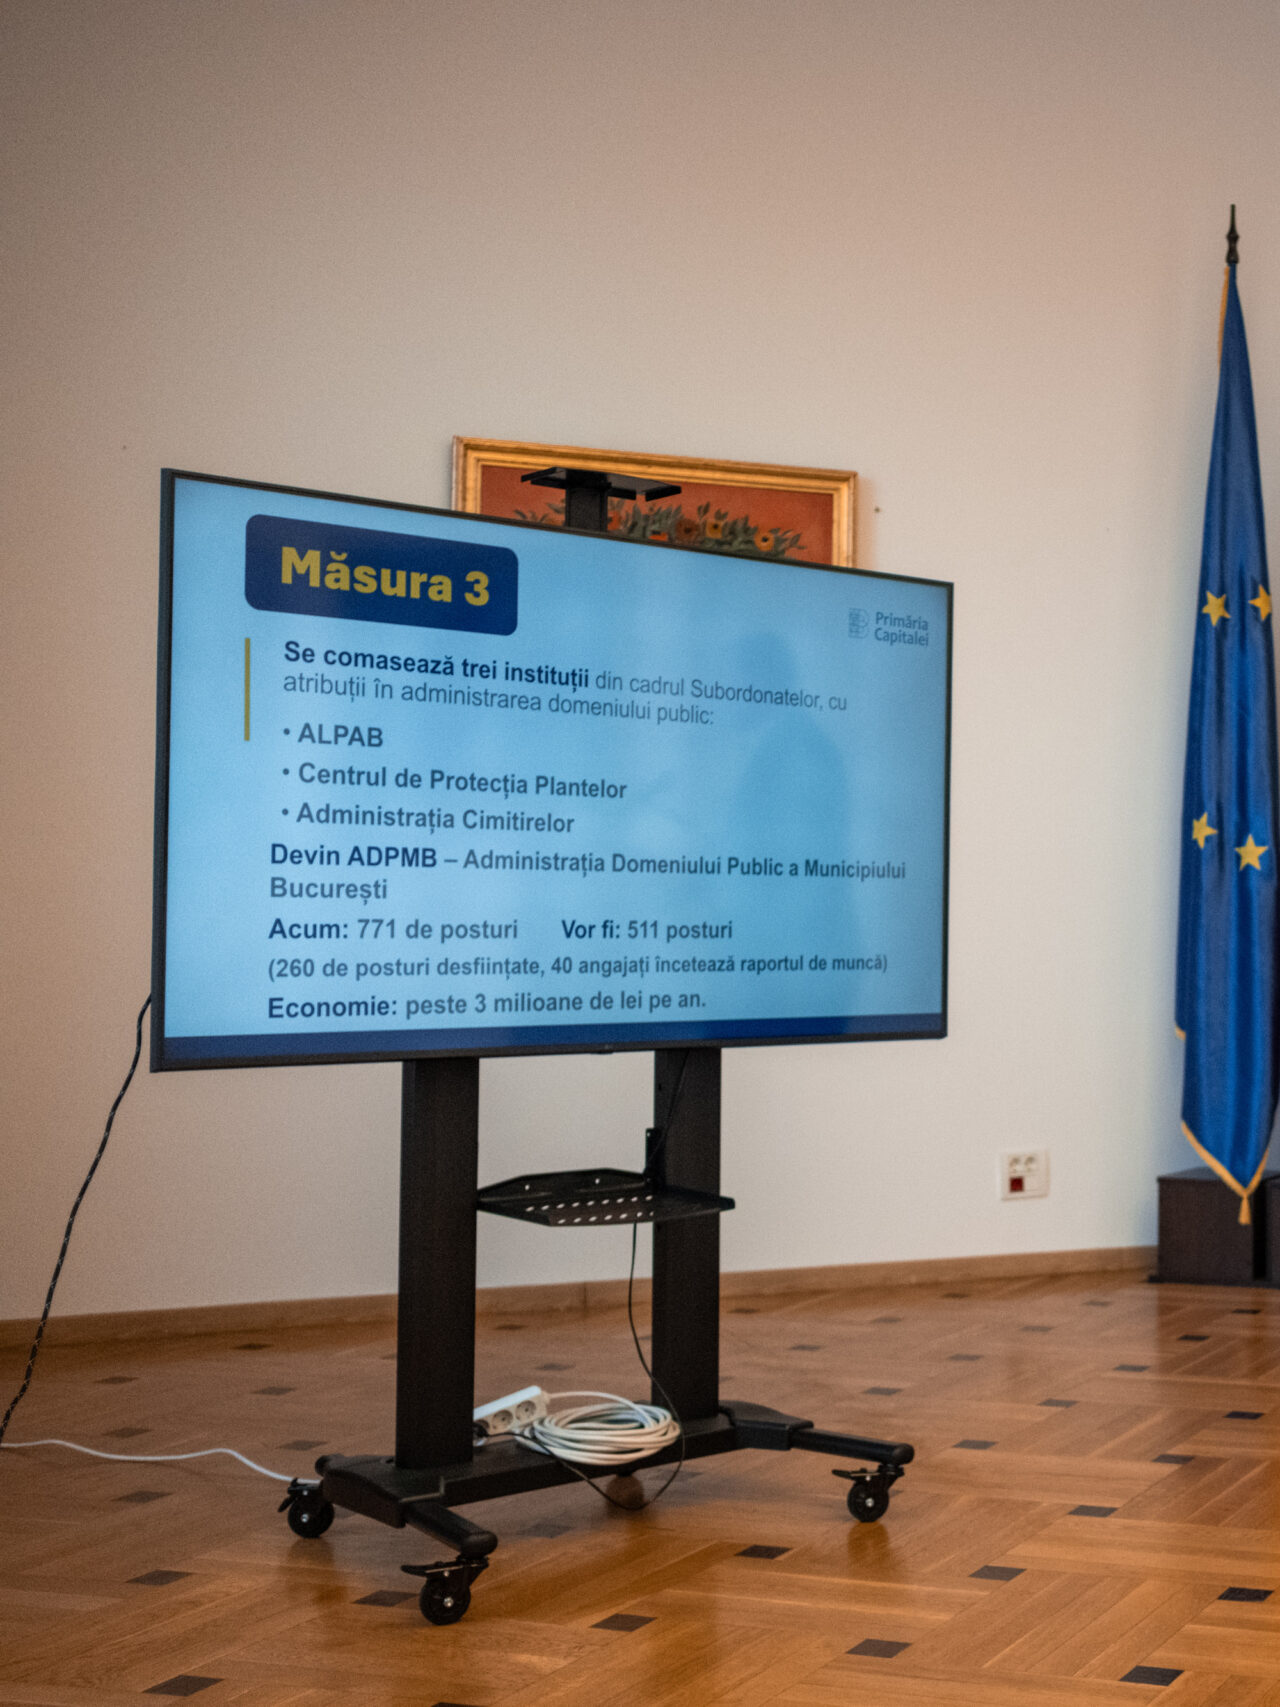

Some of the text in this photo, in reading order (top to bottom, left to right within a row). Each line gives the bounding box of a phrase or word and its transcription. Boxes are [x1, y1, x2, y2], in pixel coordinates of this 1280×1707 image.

[281, 546, 489, 606] Măsura 3
[876, 612, 928, 631] Primăria
[875, 627, 928, 648] Capitalei
[284, 640, 847, 711] Se comasează trei instituții din cadrul Subordonatelor, cu
[284, 672, 714, 726] atribuții în administrarea domeniului public:
[298, 723, 383, 747] ALPAB
[298, 763, 627, 799] Centrul de Protecția Plantelor
[296, 802, 574, 834] Administrația Cimitirelor
[270, 844, 340, 866] Devin
[347, 846, 437, 867] ADPMB
[464, 849, 604, 877] Administrația
[612, 853, 721, 875] Domeniului
[728, 857, 783, 877] Public
[789, 863, 798, 877] a
[804, 859, 906, 882] Municipiului
[270, 877, 387, 906] București
[268, 918, 732, 944] Acum: 771 de posturi Vor fi: 511 posturi
[268, 954, 887, 983] (260 de posturi desființate, 40 angajați încetează raportul de muncă)
[268, 991, 706, 1019] Economie: peste 3 milioane de lei pe an.
